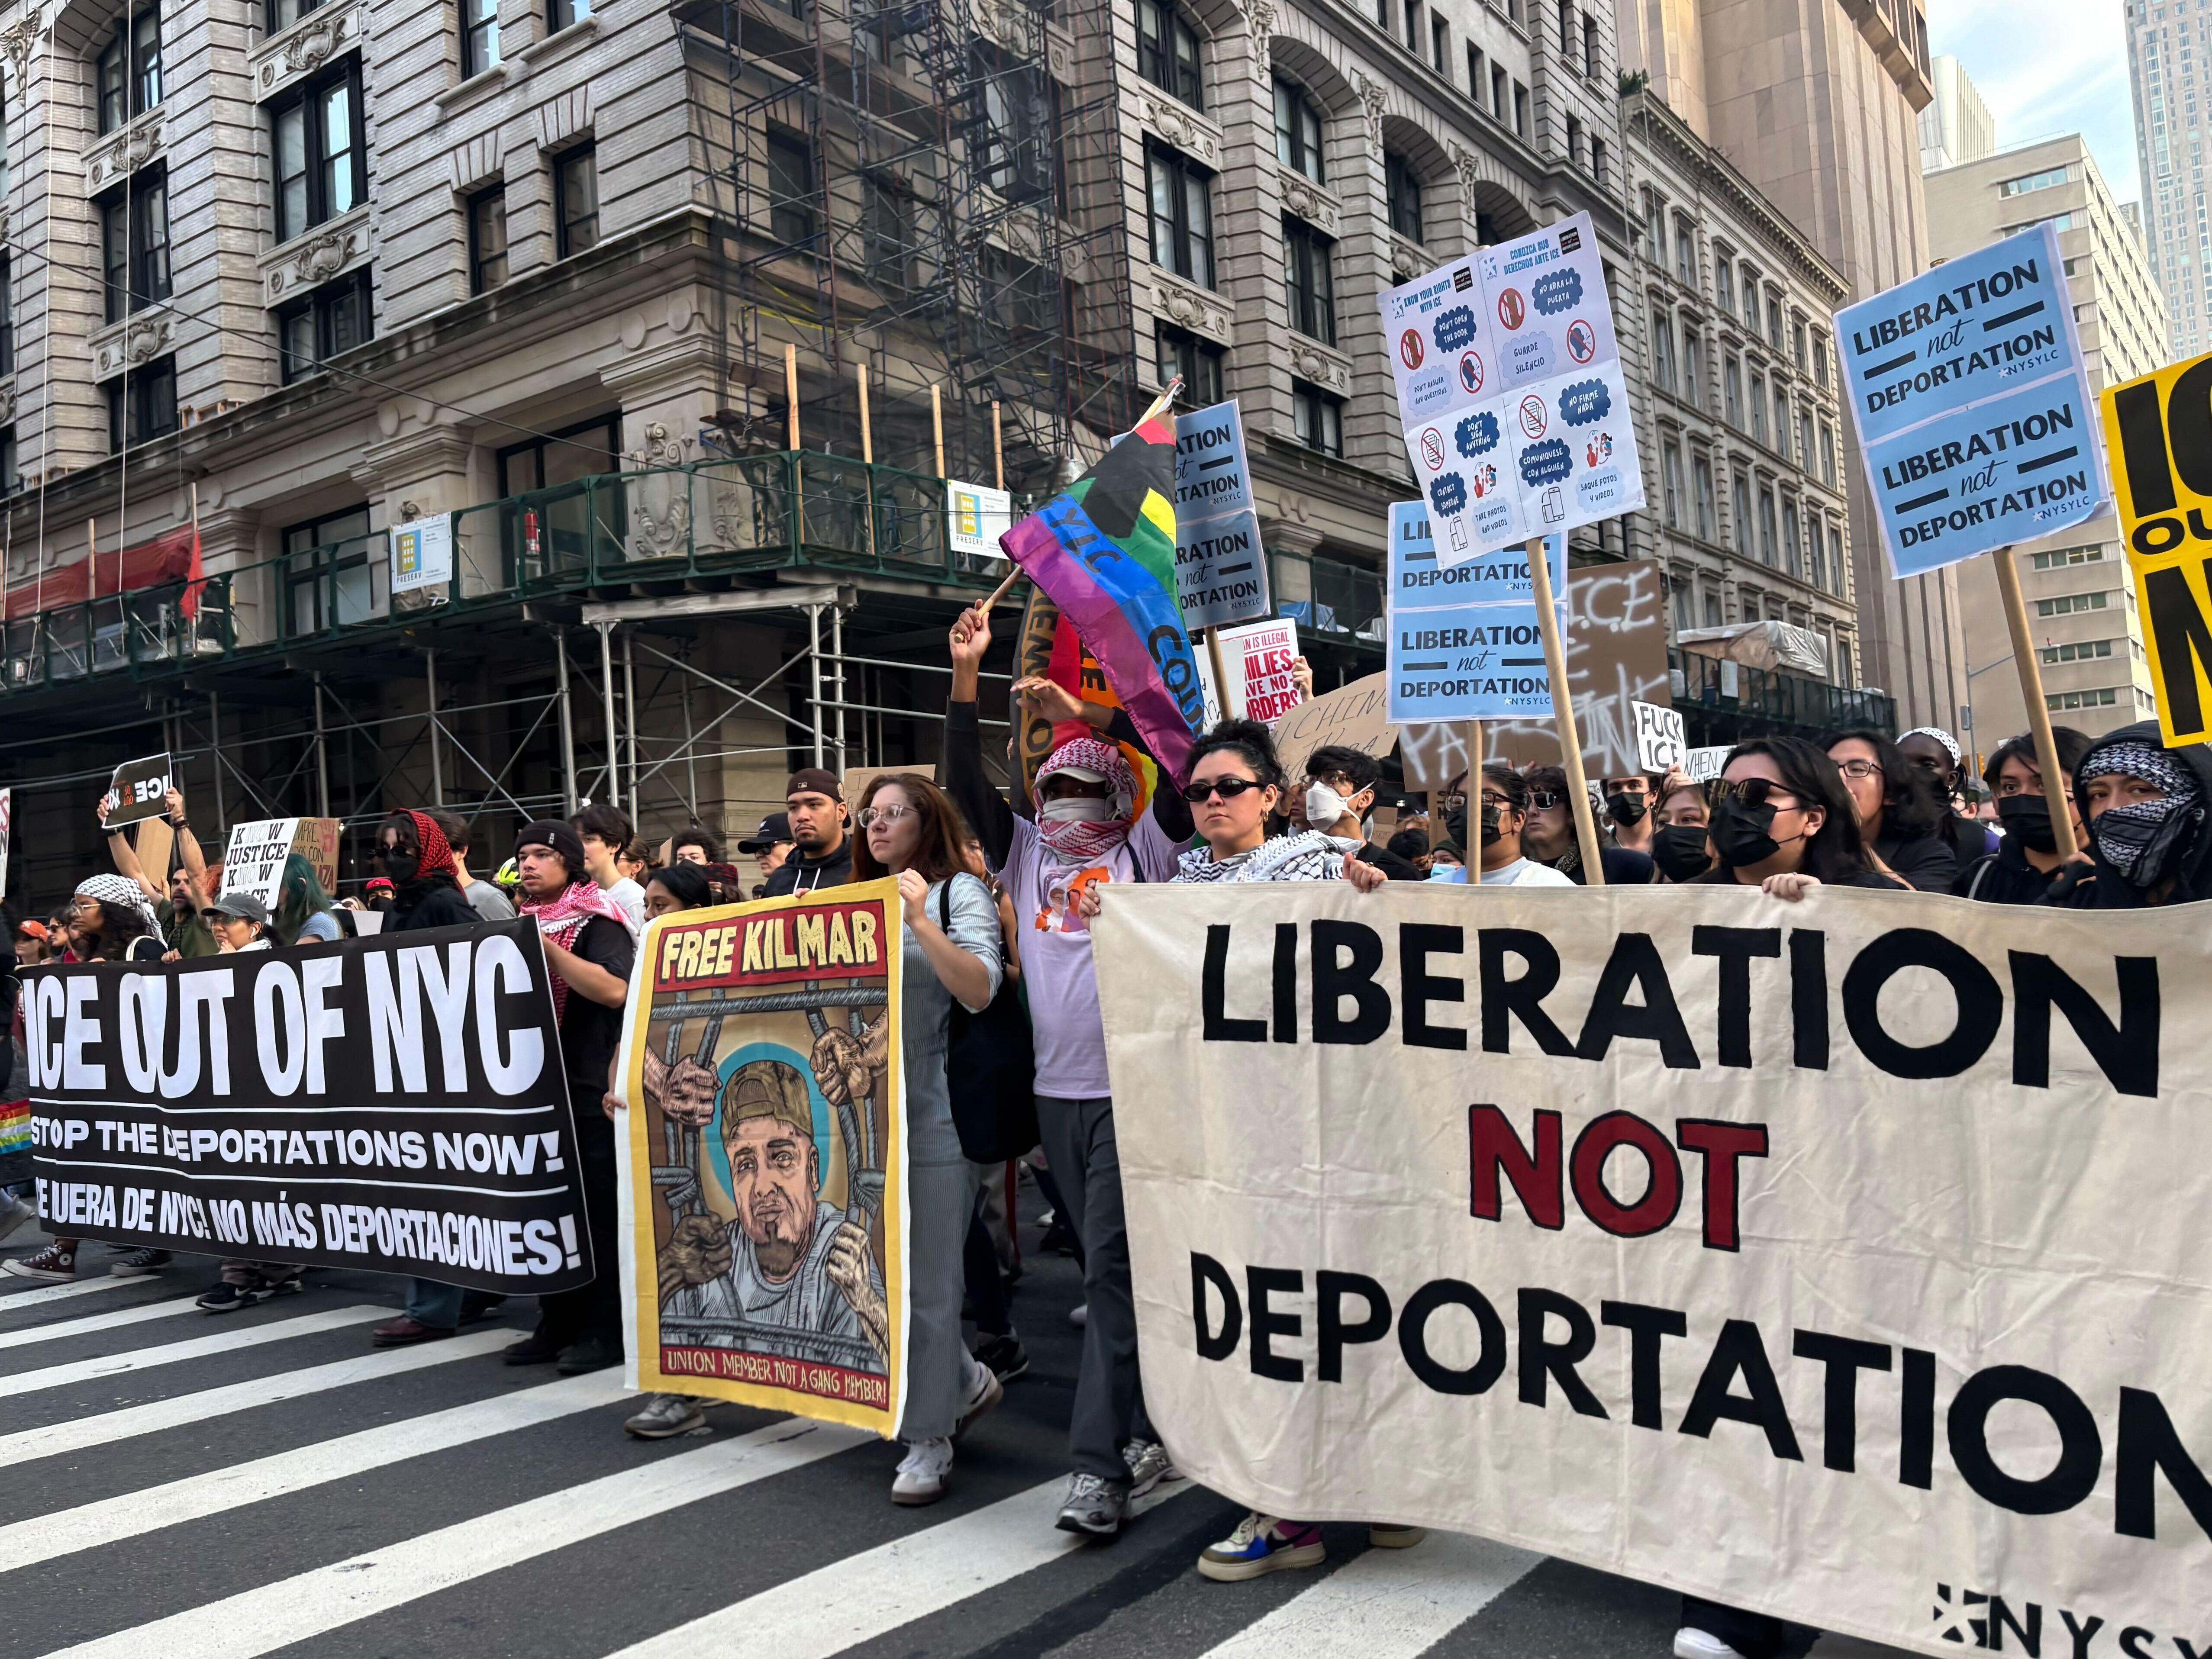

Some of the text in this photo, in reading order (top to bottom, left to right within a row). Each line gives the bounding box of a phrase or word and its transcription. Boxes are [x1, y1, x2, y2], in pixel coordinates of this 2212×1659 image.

[1503, 248, 1560, 275] DERECHOS ANTE ICE
[1404, 294, 1418, 307] KNOW
[1419, 287, 1432, 301] YOUR
[1433, 279, 1451, 294] RIGHTS
[1540, 277, 1573, 295] NO ABRA LA
[1420, 301, 1432, 313] WITH
[1547, 292, 1570, 306] PUERTA
[1853, 258, 2040, 356] LIBERATION
[1439, 314, 1467, 332] DON'T OPEN
[1444, 329, 1468, 344] THE DOOR
[1927, 319, 1975, 358] not
[1514, 342, 1538, 357] GUARDE
[1516, 357, 1544, 374] SILENCIO
[1867, 324, 2054, 413] DEPORTATION
[2007, 349, 2058, 376] NYSYLC
[1569, 390, 1598, 407] NO FIRME
[1578, 404, 1593, 415] NADA
[1467, 420, 1483, 432] DON'T
[1471, 429, 1483, 440] SIGN
[1466, 436, 1490, 451] ANYTHING
[1882, 403, 2073, 490] LIBERATION
[1523, 448, 1563, 464] COMUNIQUESE
[1175, 459, 1194, 480] ot
[1527, 462, 1564, 477] CON ALGUIEN
[1960, 461, 2008, 497] not
[1581, 474, 1617, 491] SAQUE FOTOS
[1595, 489, 1614, 501] VIDEOS
[1488, 505, 1506, 518] PHOTOS
[1899, 470, 2087, 548] DEPORTATION
[2041, 496, 2089, 520] NYSYLC
[1491, 519, 1507, 531] VIDEOS
[1175, 532, 1249, 566] RATION
[397, 572, 422, 583] PRESERV
[1186, 564, 1214, 586] not
[1180, 580, 1258, 610] ORTATION
[1232, 598, 1260, 609] NYSYLC
[1252, 637, 1260, 648] IS
[1261, 631, 1290, 646] ILLEGAL
[1457, 650, 1496, 672] not
[1270, 675, 1288, 692] NO
[1400, 677, 1550, 698] DEPORTATION
[1640, 706, 1682, 744] FUCK
[1647, 740, 1678, 768] ICE
[135, 775, 169, 803] ICE
[234, 822, 284, 845] KNOW
[226, 843, 288, 867] JUSTICE
[309, 846, 324, 863] CON
[227, 863, 274, 887] KNOW
[661, 910, 877, 982] FREE KILMAR
[23, 935, 545, 1098] ICE OUT OF NYC
[1201, 918, 2159, 1098] LIBERATION
[31, 1115, 564, 1176] STOP THE DEPORTATIONS NOW!
[1469, 1104, 1769, 1253] NOT
[122, 1187, 155, 1232] DE
[209, 1199, 248, 1244] NO
[252, 1190, 317, 1250] MÁS
[322, 1203, 581, 1276] DEPORTACIONES!
[667, 1350, 887, 1404] UNION MEMBER NOT A GANG MEMBER!
